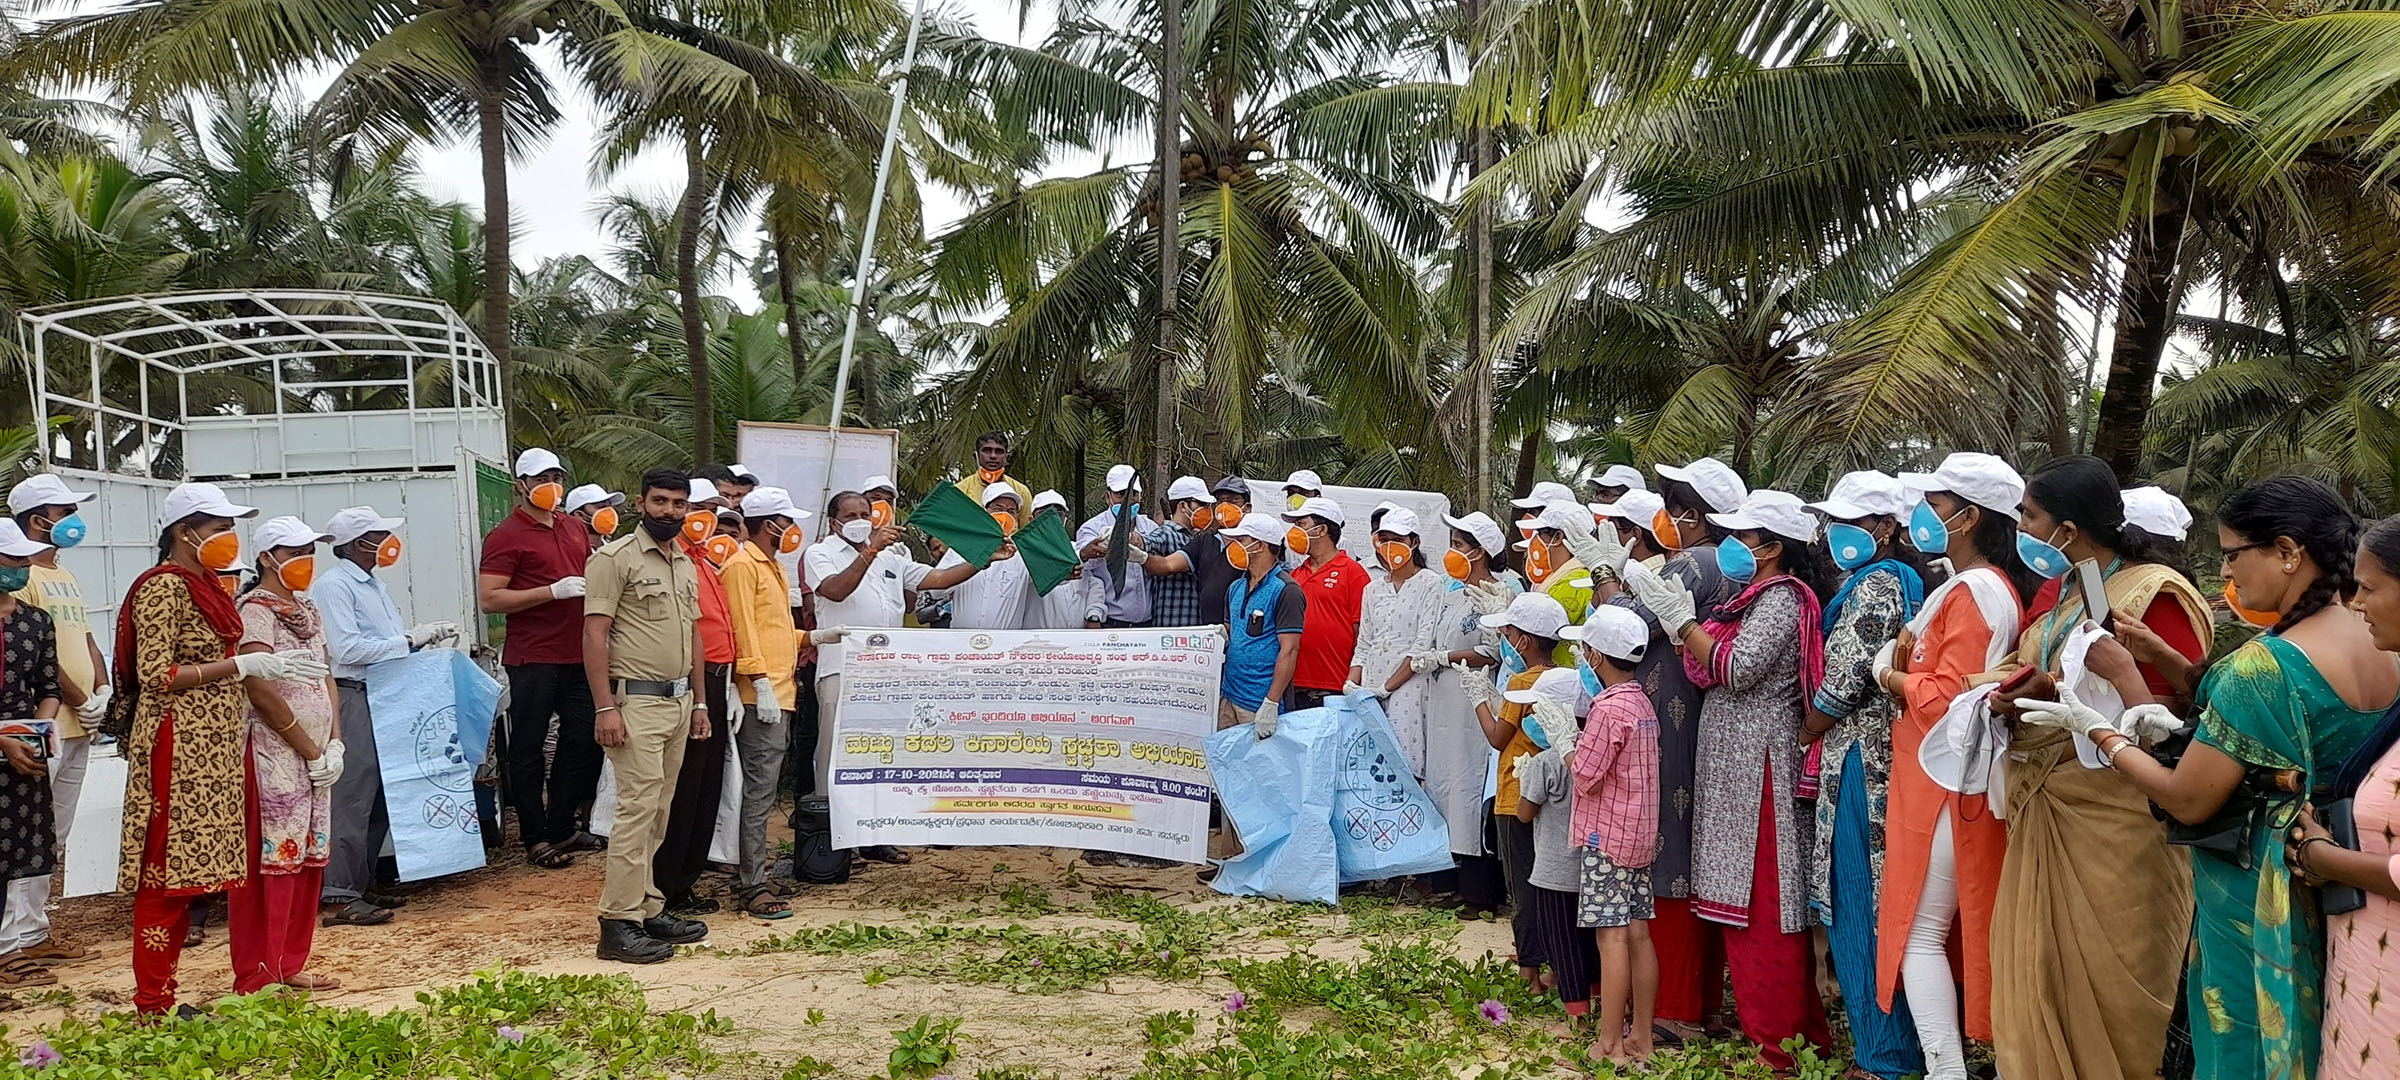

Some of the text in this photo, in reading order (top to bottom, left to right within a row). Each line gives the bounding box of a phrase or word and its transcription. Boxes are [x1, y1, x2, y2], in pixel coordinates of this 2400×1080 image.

[1161, 636, 1214, 650] SLRM
[856, 652, 896, 661] ಕರ್ನಾಟಕ
[901, 652, 923, 664] ರಾಜ್ಯ
[927, 652, 950, 662] ಗ್ರಾಮ
[954, 651, 1004, 661] ಪಂಚಾಯತ್
[1008, 650, 1041, 660] ನೌಕರರ
[1107, 652, 1127, 662] ಸಂಘ
[972, 666, 1098, 676] ಉಡುಪಿ ಜಿಲ್ಲಾ ಸಮಿತಿ ವತಿಯಿಂದ
[853, 680, 900, 690] ಜಿಲ್ಲಾಡಳಿತ
[947, 680, 970, 688] ಜಿಲ್ಲಾ
[975, 679, 1032, 687] ಪಂಚಾಯತ್
[1100, 680, 1134, 689] ಭಾರತ್
[1139, 682, 1171, 692] ಮಿಷನ್
[1176, 686, 1206, 697] ಉಡುಪಿ
[887, 693, 913, 703] ಗ್ರಾಮ
[919, 692, 976, 700] ಪಂಚಾಯತ್
[981, 692, 1013, 701] ಹಾಗೂ
[1018, 693, 1043, 701] ವಿವಿಧ
[1048, 693, 1072, 702] ಸಂಘ
[1077, 693, 1117, 706] ಸಂಸ್ಥೆಗಳ
[1122, 695, 1207, 712] ಸಹಯೋಗದೊಂದಿಗೆ
[949, 711, 977, 725] ಕ್ಲೀನ್
[981, 711, 1026, 722] ಇಂಡಿಯಾ
[1031, 711, 1076, 723] ಅಭಿಯಾನ
[1090, 713, 1136, 725] ಅಂಗವಾಗಿ
[845, 733, 895, 764] ಮಟ್ಟು
[904, 731, 955, 753] ಕಡಲ
[963, 729, 1052, 753] ಕಿನಾರೆಯ
[1129, 738, 1207, 770] ಅಭಿಯಾನ
[840, 771, 874, 781] ದಿನಾಂಕ
[884, 769, 955, 780] 17-10-2021ನೇ
[958, 770, 1002, 783] ಆದಿತ್ಯವಾರ
[1080, 773, 1111, 785] ಸಮಯ
[1161, 781, 1181, 793] 8.00
[1022, 785, 1046, 794] ಕಡೆಗೆ
[1050, 787, 1078, 795] ಒಂದು
[1003, 801, 1036, 809] ಆದರದ
[1040, 801, 1069, 812] ಸ್ವಾಗತ
[1072, 803, 1112, 814] ಬಯಸುವ
[1107, 823, 1134, 834] ಹಾಗೂ
